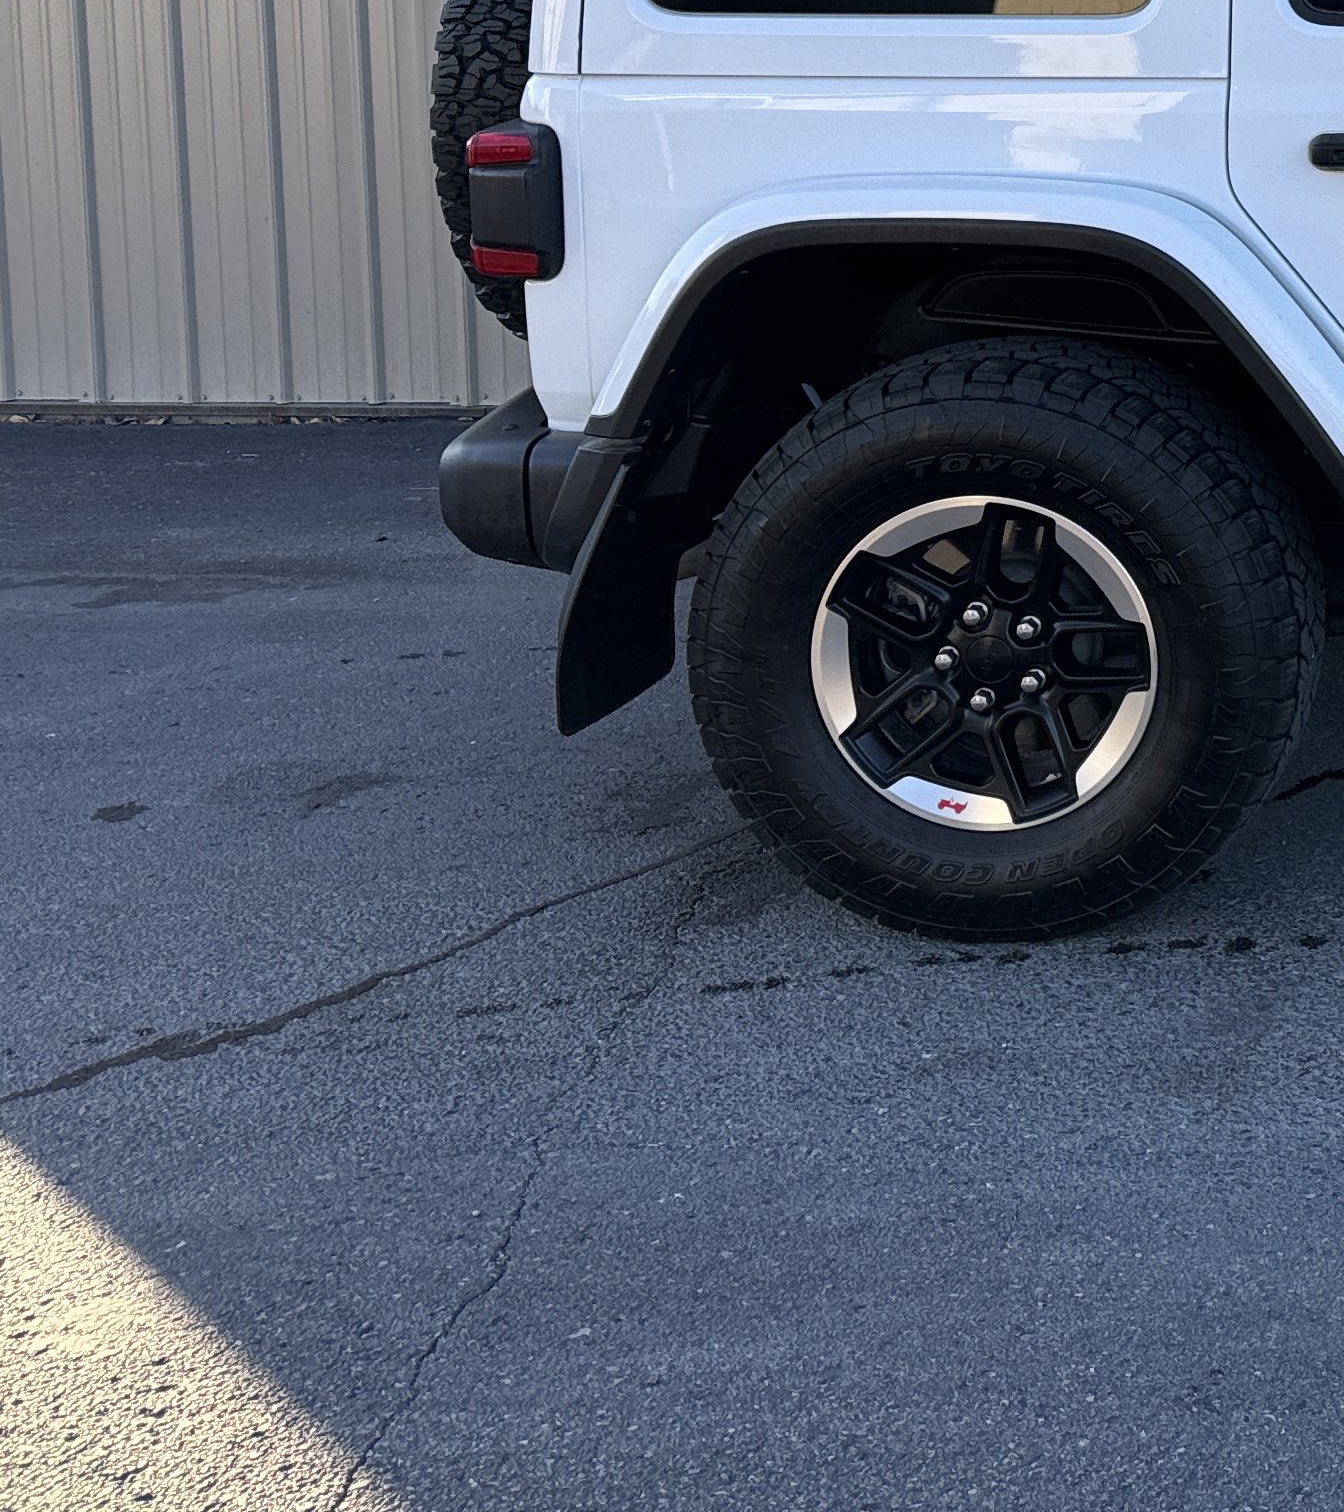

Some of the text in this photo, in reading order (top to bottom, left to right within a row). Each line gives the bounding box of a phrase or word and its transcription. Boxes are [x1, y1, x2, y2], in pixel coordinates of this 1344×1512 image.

[904, 452, 1182, 587] TOYO TIRES
[1003, 817, 1128, 885] OPEN
